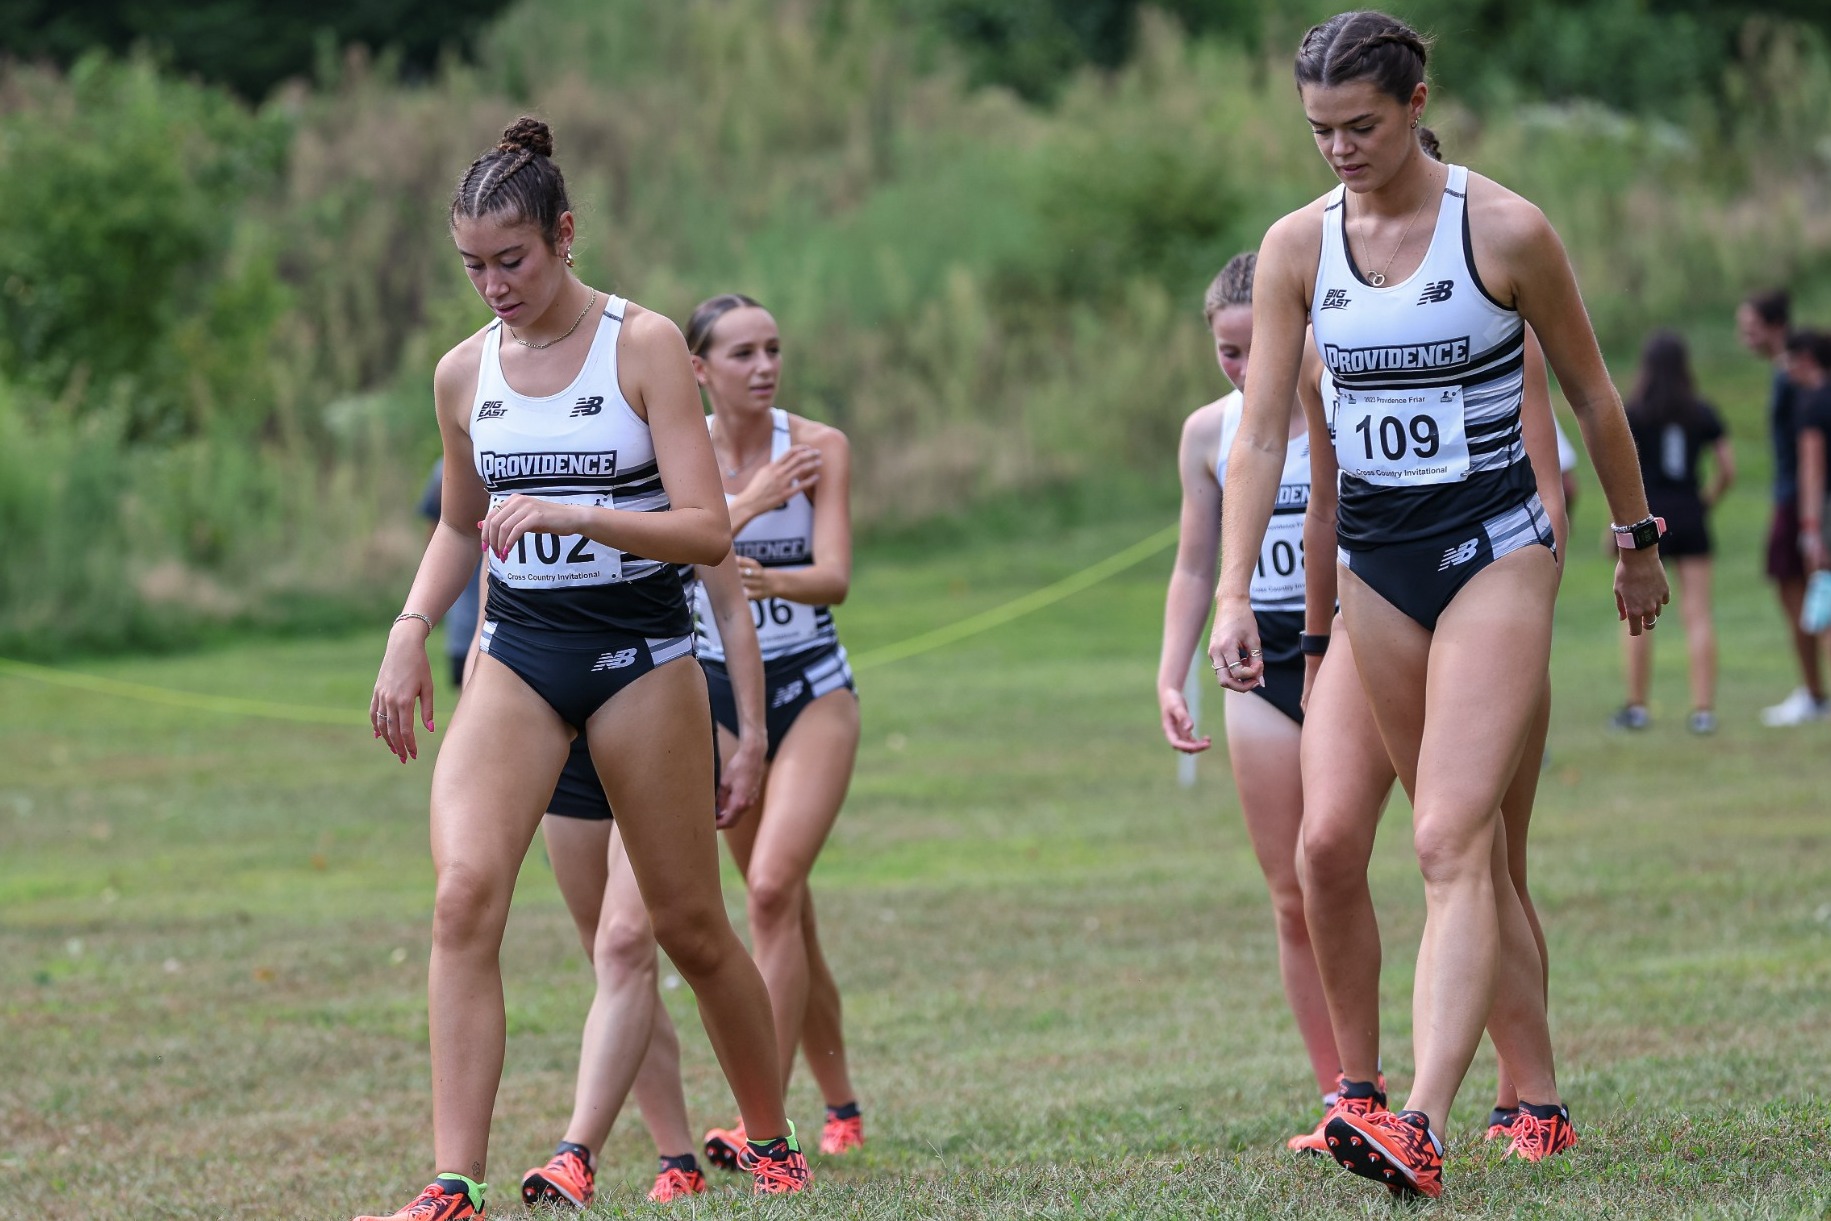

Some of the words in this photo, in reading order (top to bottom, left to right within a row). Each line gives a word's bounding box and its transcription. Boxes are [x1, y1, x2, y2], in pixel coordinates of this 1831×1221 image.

[1323, 299, 1351, 307] EAST
[1326, 289, 1347, 298] BIG
[1417, 280, 1454, 306] NB
[1325, 338, 1469, 377] PROVIDENCE
[482, 401, 503, 409] BIG
[569, 396, 604, 417] NB
[1377, 396, 1407, 404] Providence
[478, 409, 508, 417] EAST
[1356, 414, 1440, 461] 109
[481, 453, 614, 485] PROVIDENCE
[1376, 469, 1402, 478] Country
[1404, 466, 1448, 477] Invitational
[517, 532, 595, 565] 102
[1438, 538, 1479, 571] NB
[528, 573, 556, 582] Country
[557, 571, 600, 580] Invitational
[591, 648, 637, 671] NB
